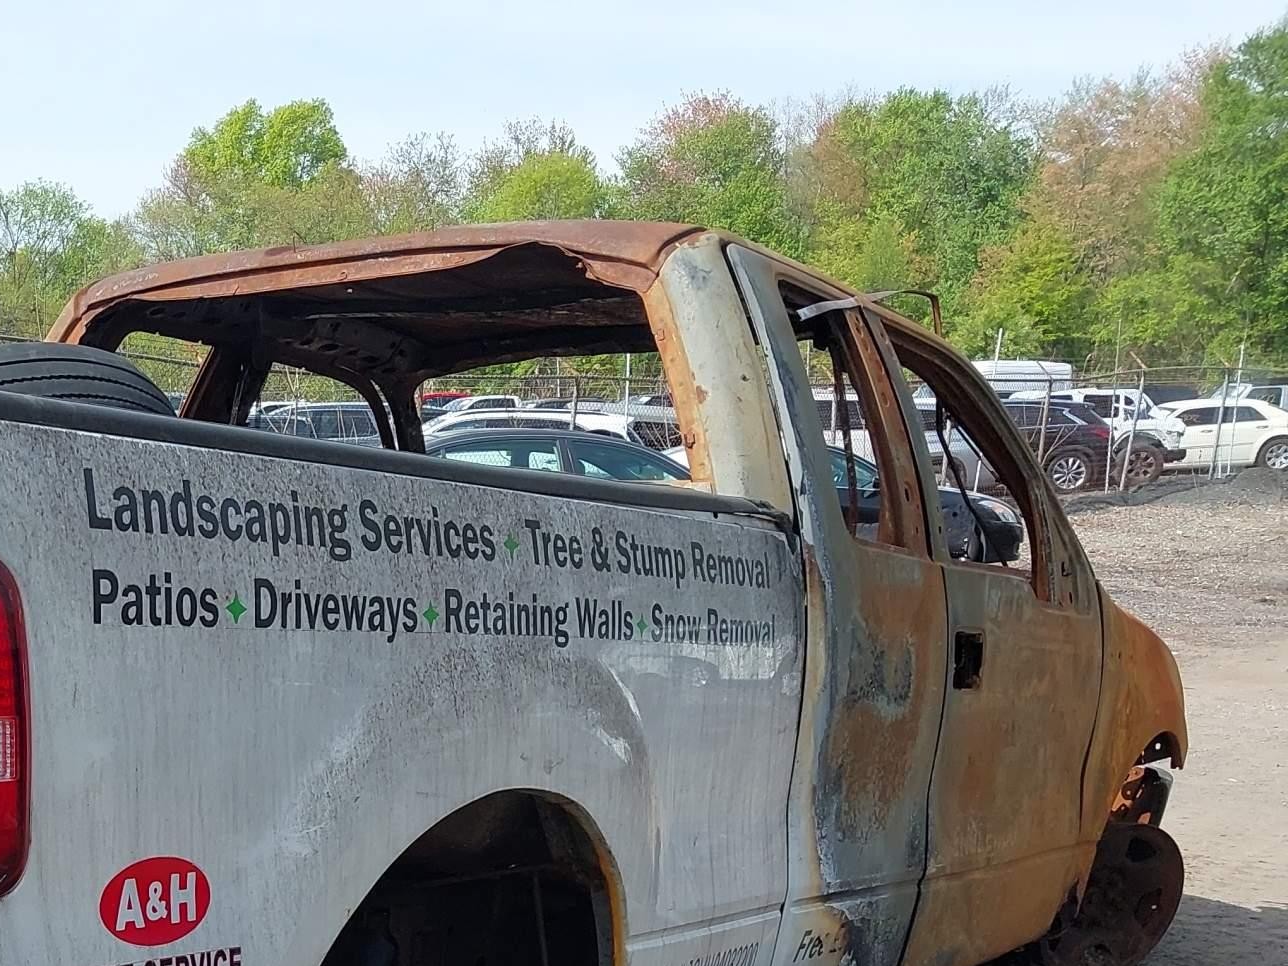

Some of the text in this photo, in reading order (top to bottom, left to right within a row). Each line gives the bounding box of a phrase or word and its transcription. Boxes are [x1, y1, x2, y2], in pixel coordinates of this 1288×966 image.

[83, 467, 771, 589] Landscaping Services Tree & Stump Removal
[92, 569, 776, 649] Patios Driveways Retaining Walls Snow Removal
[115, 871, 198, 931] A&H
